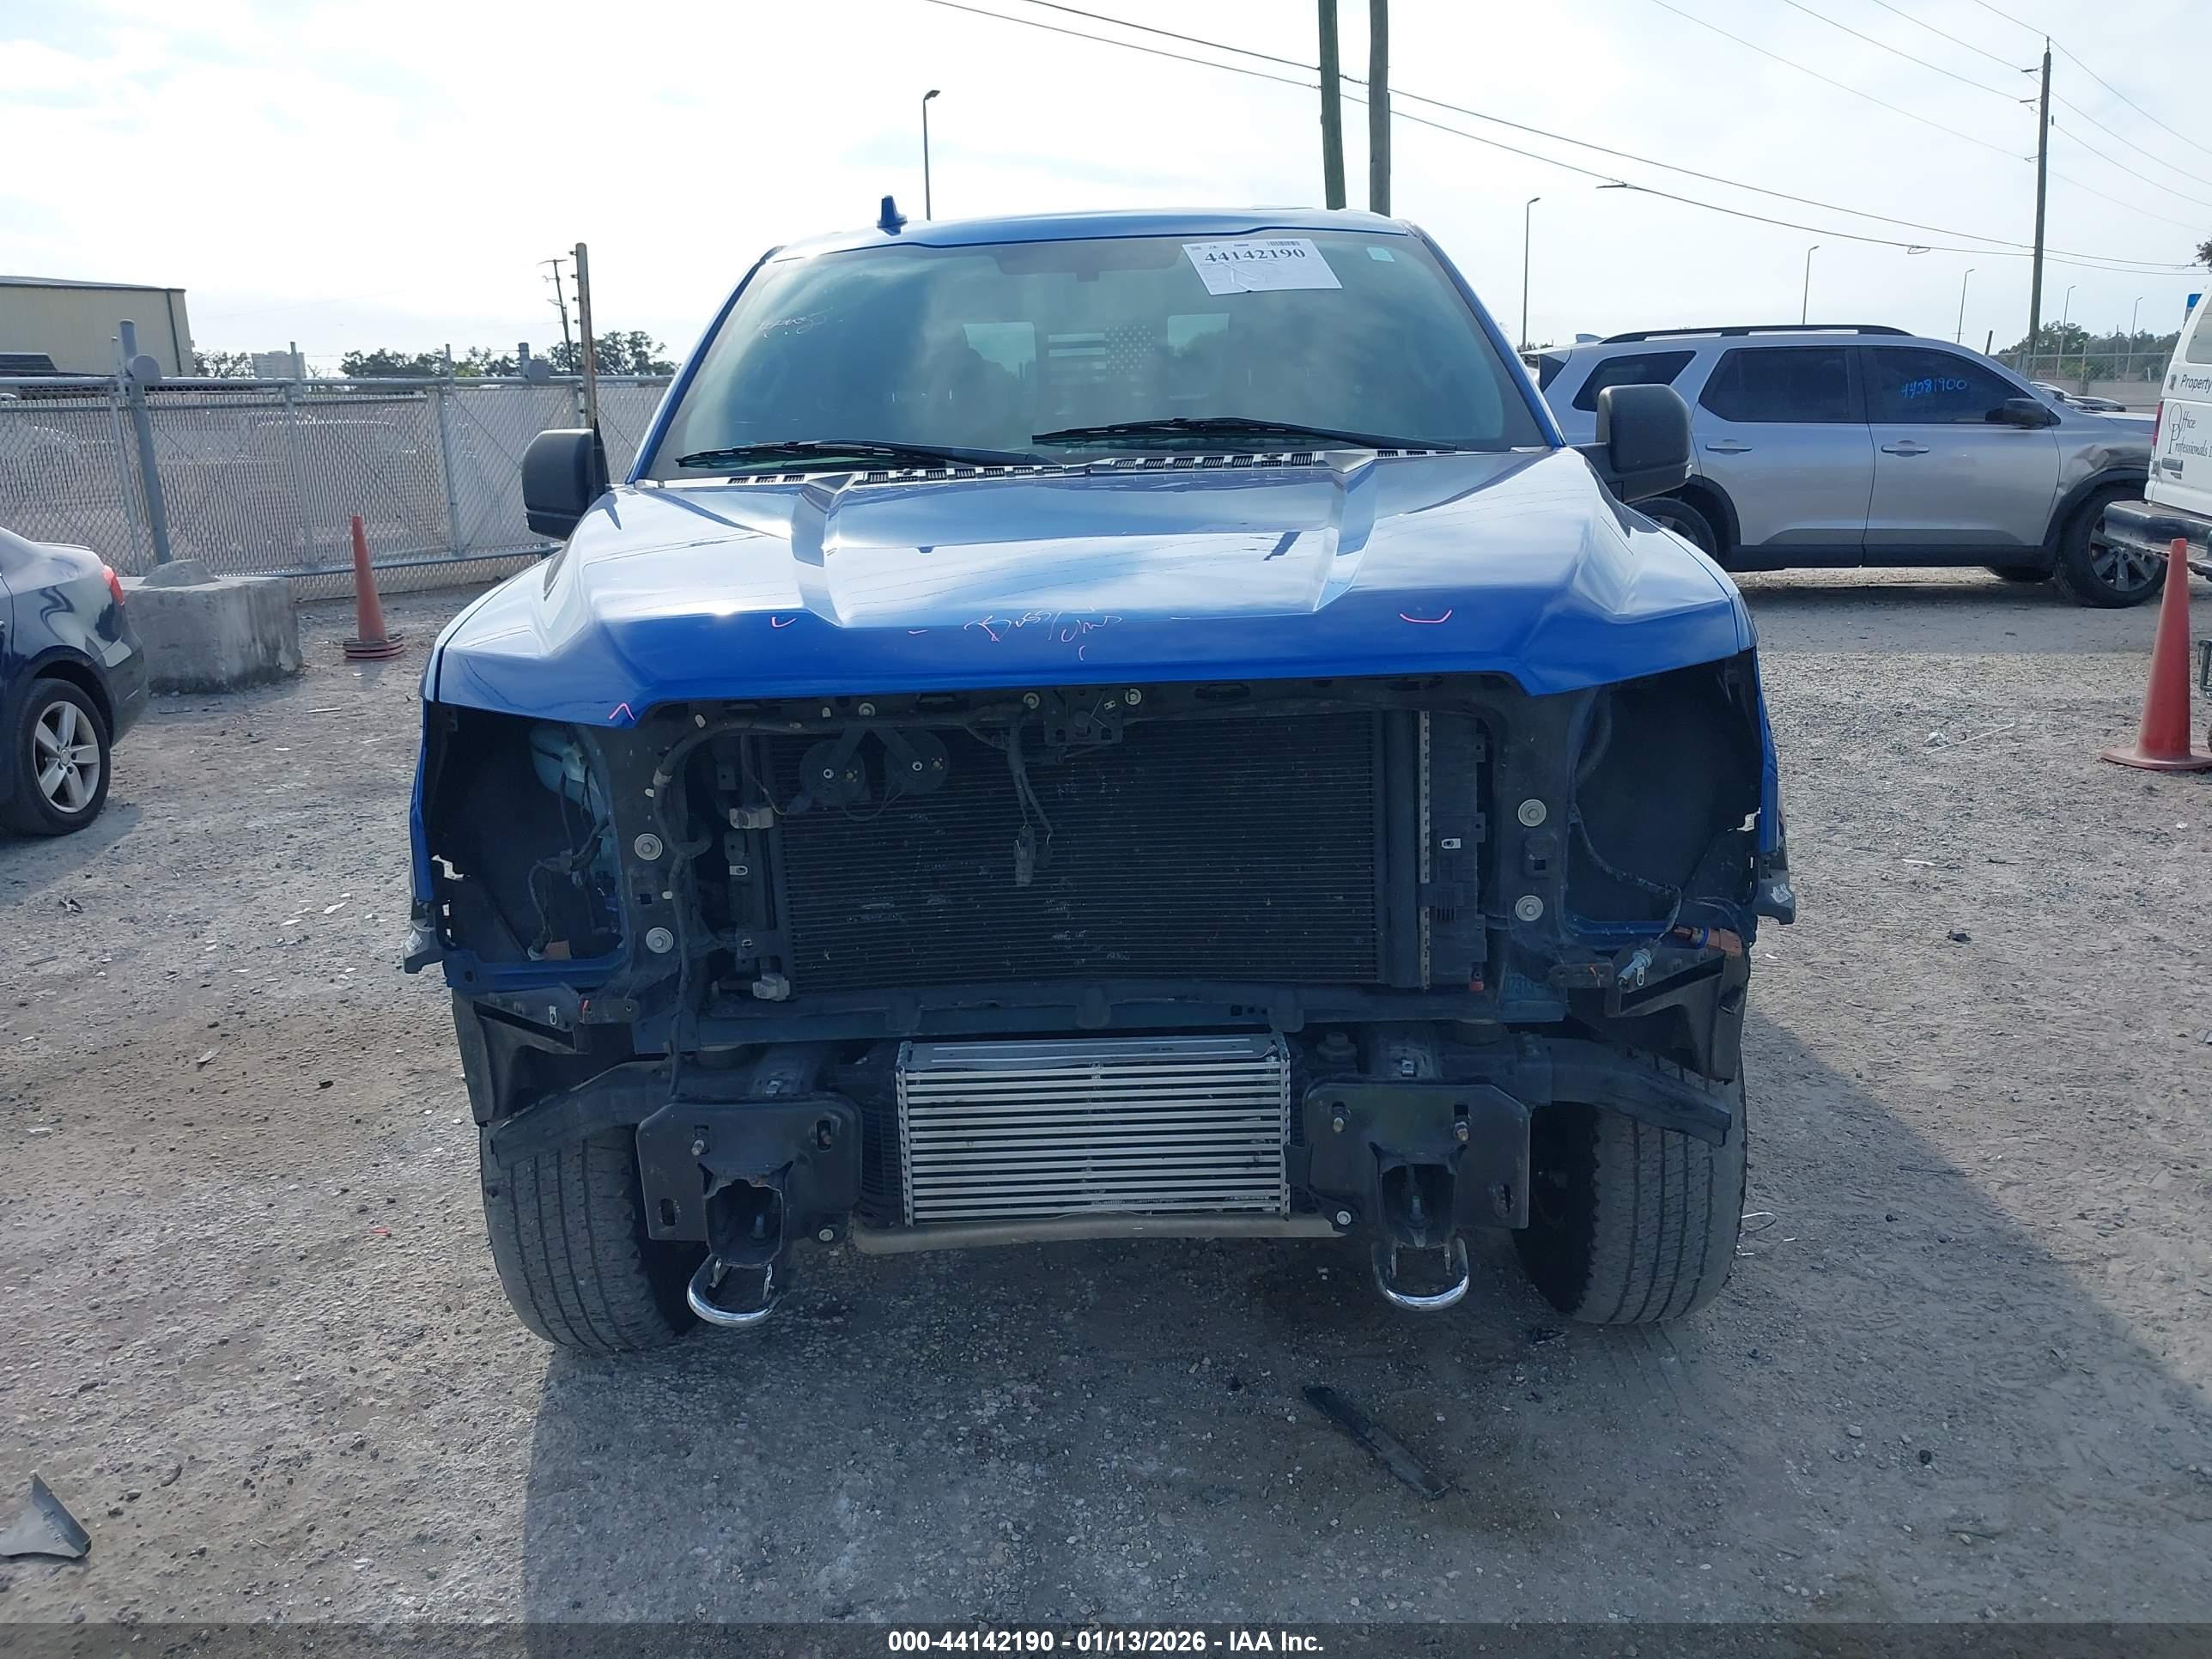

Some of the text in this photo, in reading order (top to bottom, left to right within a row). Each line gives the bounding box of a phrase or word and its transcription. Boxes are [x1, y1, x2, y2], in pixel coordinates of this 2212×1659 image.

[1205, 248, 1306, 263] 44142190
[2180, 374, 2212, 393] Property
[2168, 403, 2197, 432] Office
[2168, 423, 2208, 457] Professionals
